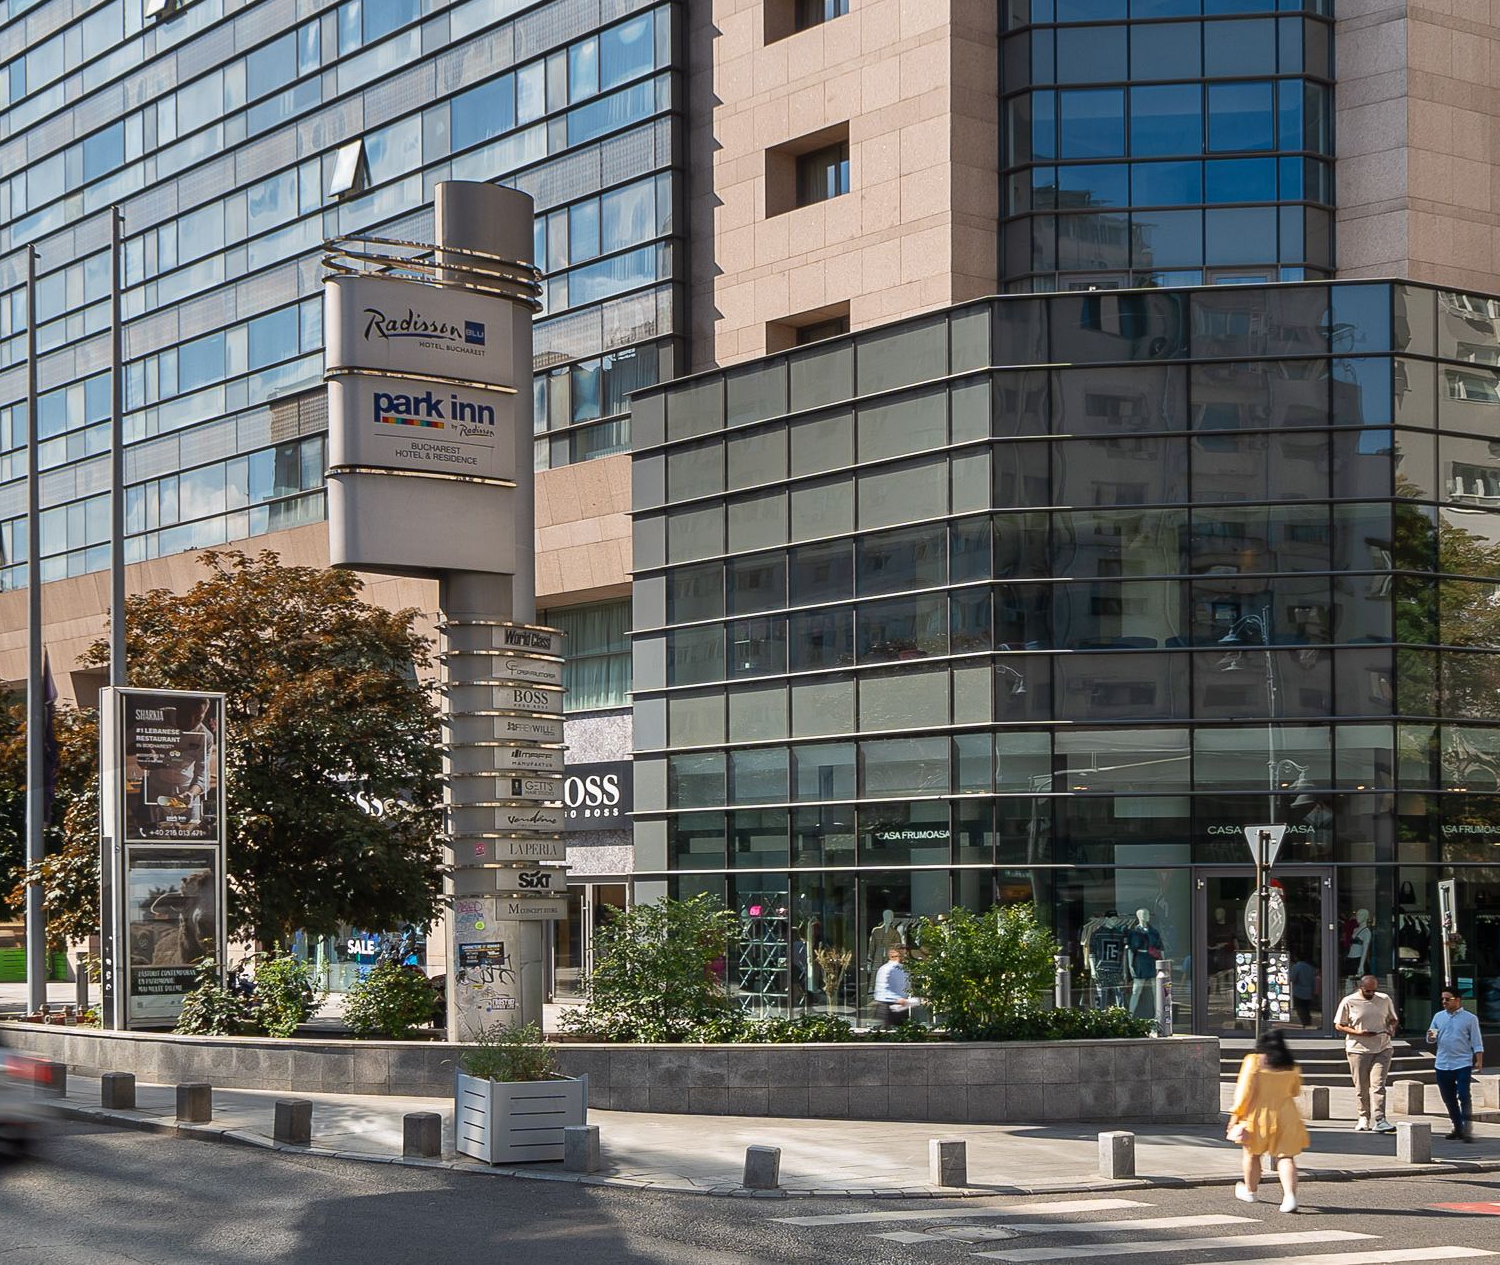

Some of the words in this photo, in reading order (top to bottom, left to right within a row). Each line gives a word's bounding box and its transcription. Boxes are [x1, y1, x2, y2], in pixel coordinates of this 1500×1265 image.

[364, 308, 462, 341] Radisson
[446, 345, 485, 356] BUCHAREST
[373, 391, 445, 422] park
[451, 394, 495, 425] inn
[460, 424, 495, 437] Radisson
[411, 442, 461, 454] BUCHAREST
[395, 449, 423, 460] HOTEL
[425, 452, 431, 460] &
[433, 453, 478, 465] RESIDENCE
[514, 690, 548, 704] BOSS
[564, 774, 620, 807] OSS
[584, 808, 619, 818] BOSS
[878, 831, 901, 840] CASA
[902, 830, 950, 839] FRUMOASA
[1207, 826, 1242, 834] CASA
[347, 939, 375, 954] SALE
